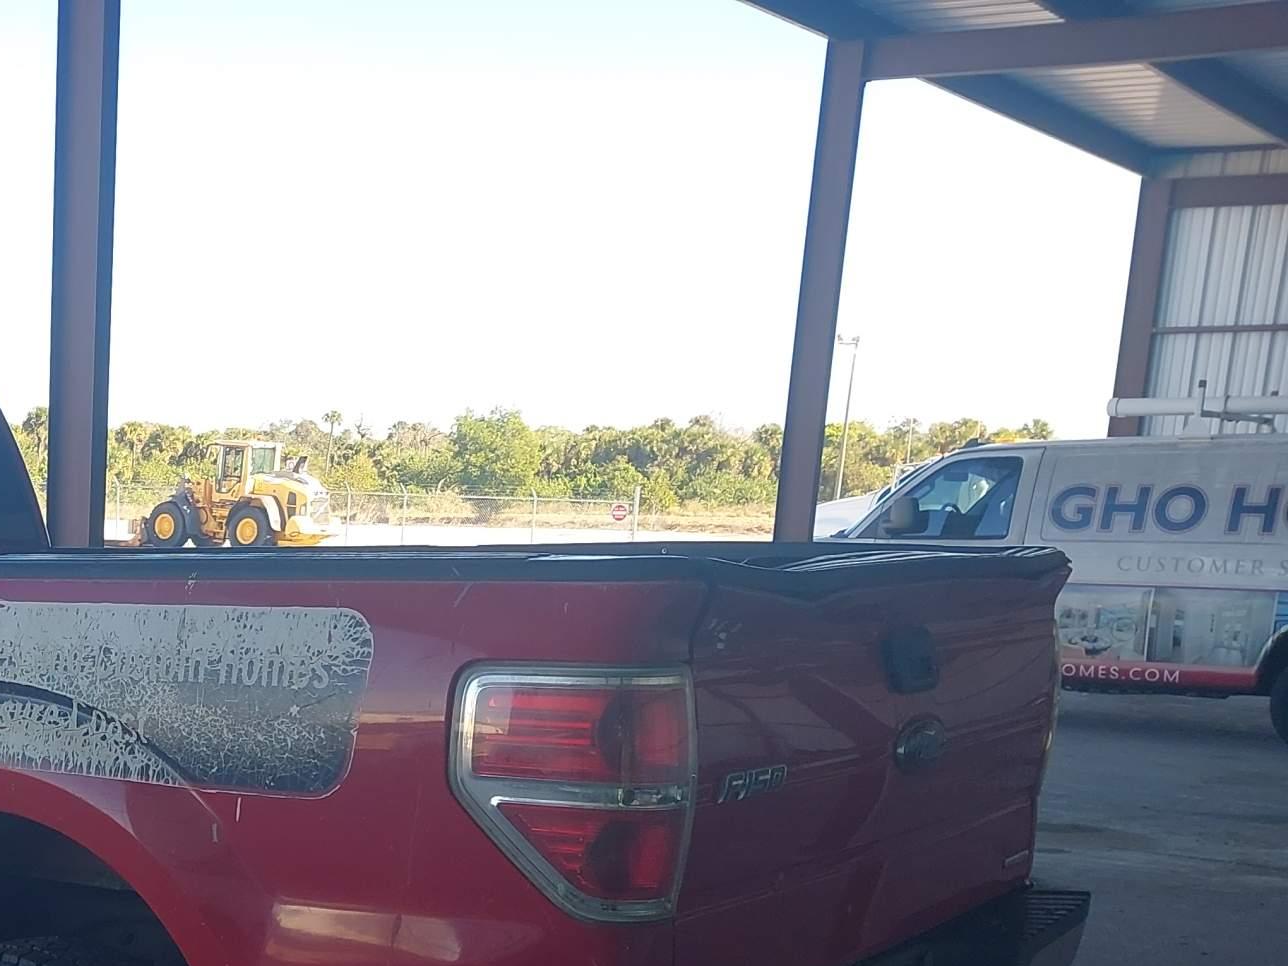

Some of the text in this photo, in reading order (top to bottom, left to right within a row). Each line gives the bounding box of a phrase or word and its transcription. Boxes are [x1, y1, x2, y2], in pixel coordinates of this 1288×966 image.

[1048, 483, 1209, 535] GHO
[1116, 555, 1265, 576] CUSTOMER
[1062, 663, 1180, 684] OMES.COM
